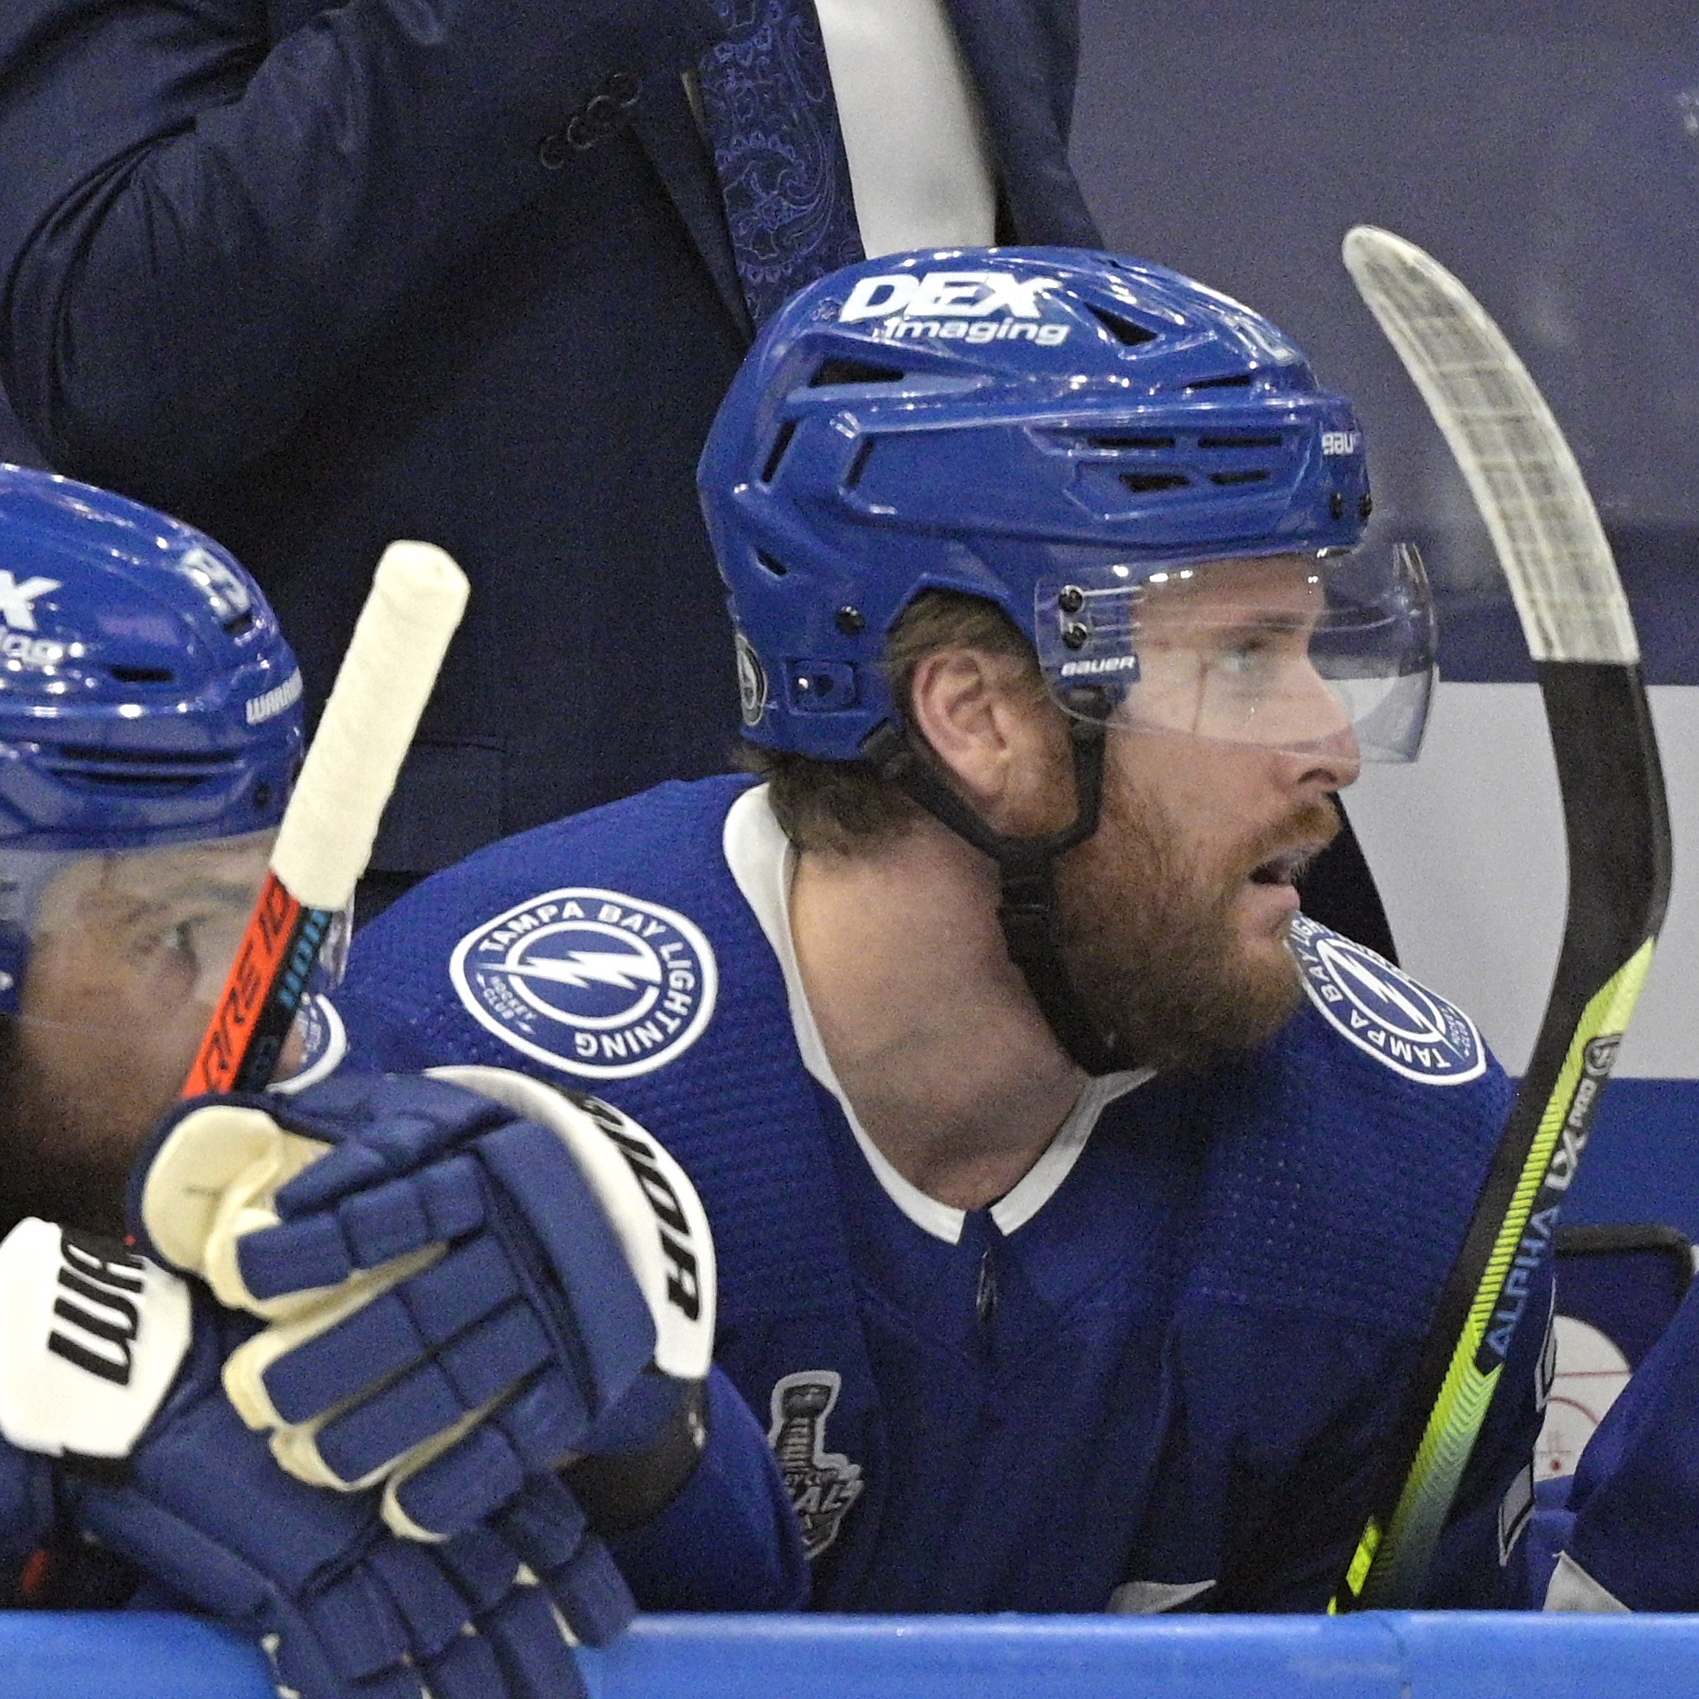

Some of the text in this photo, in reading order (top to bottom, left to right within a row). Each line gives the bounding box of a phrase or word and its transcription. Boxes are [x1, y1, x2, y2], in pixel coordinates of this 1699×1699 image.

[839, 270, 1063, 324] DEX
[884, 316, 1071, 347] imaging
[479, 900, 696, 1059] TAMPA BAY LIGHTNING
[490, 975, 538, 1021] HOCKEY
[1297, 947, 1344, 1003] BAY
[483, 989, 515, 1020] CLUB
[1350, 1008, 1451, 1068] TAMPA
[1485, 1204, 1561, 1356] ALPHA
